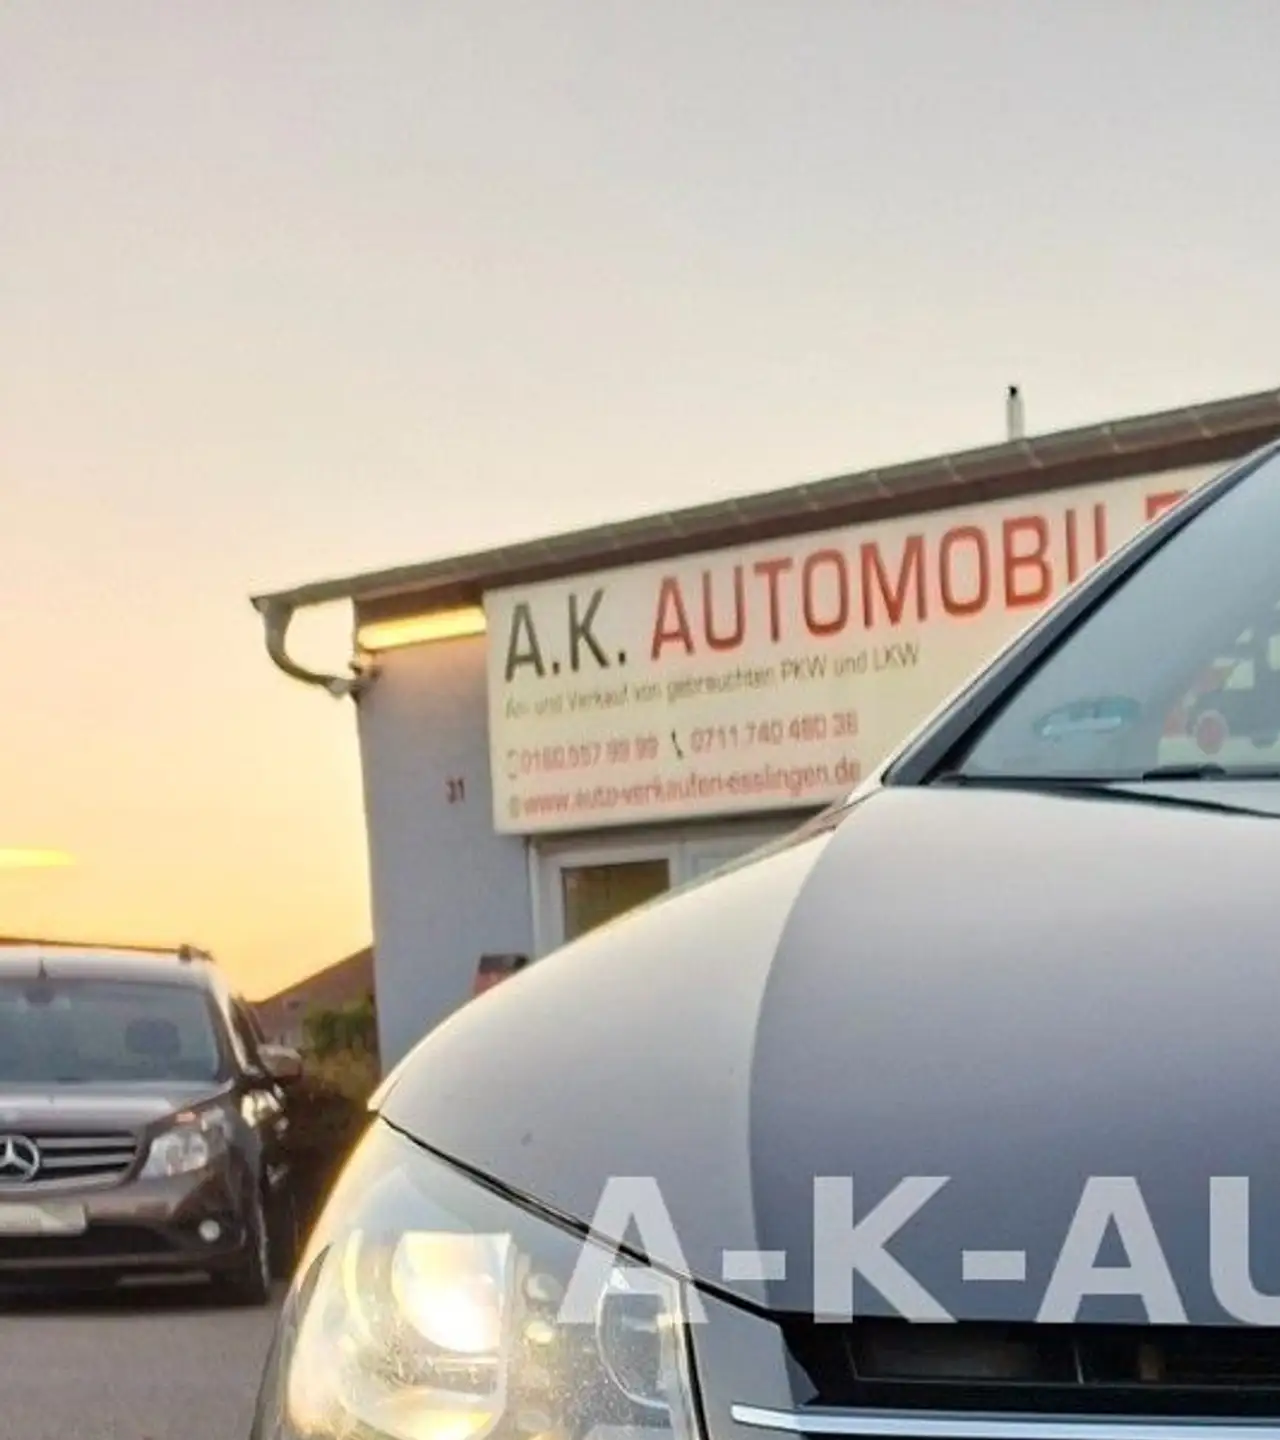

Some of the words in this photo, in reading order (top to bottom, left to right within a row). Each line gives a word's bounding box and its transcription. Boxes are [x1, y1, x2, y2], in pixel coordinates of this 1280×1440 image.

[503, 587, 628, 683] A.K.
[779, 653, 829, 682] PKW
[833, 651, 868, 676] und
[871, 642, 920, 672] LKW
